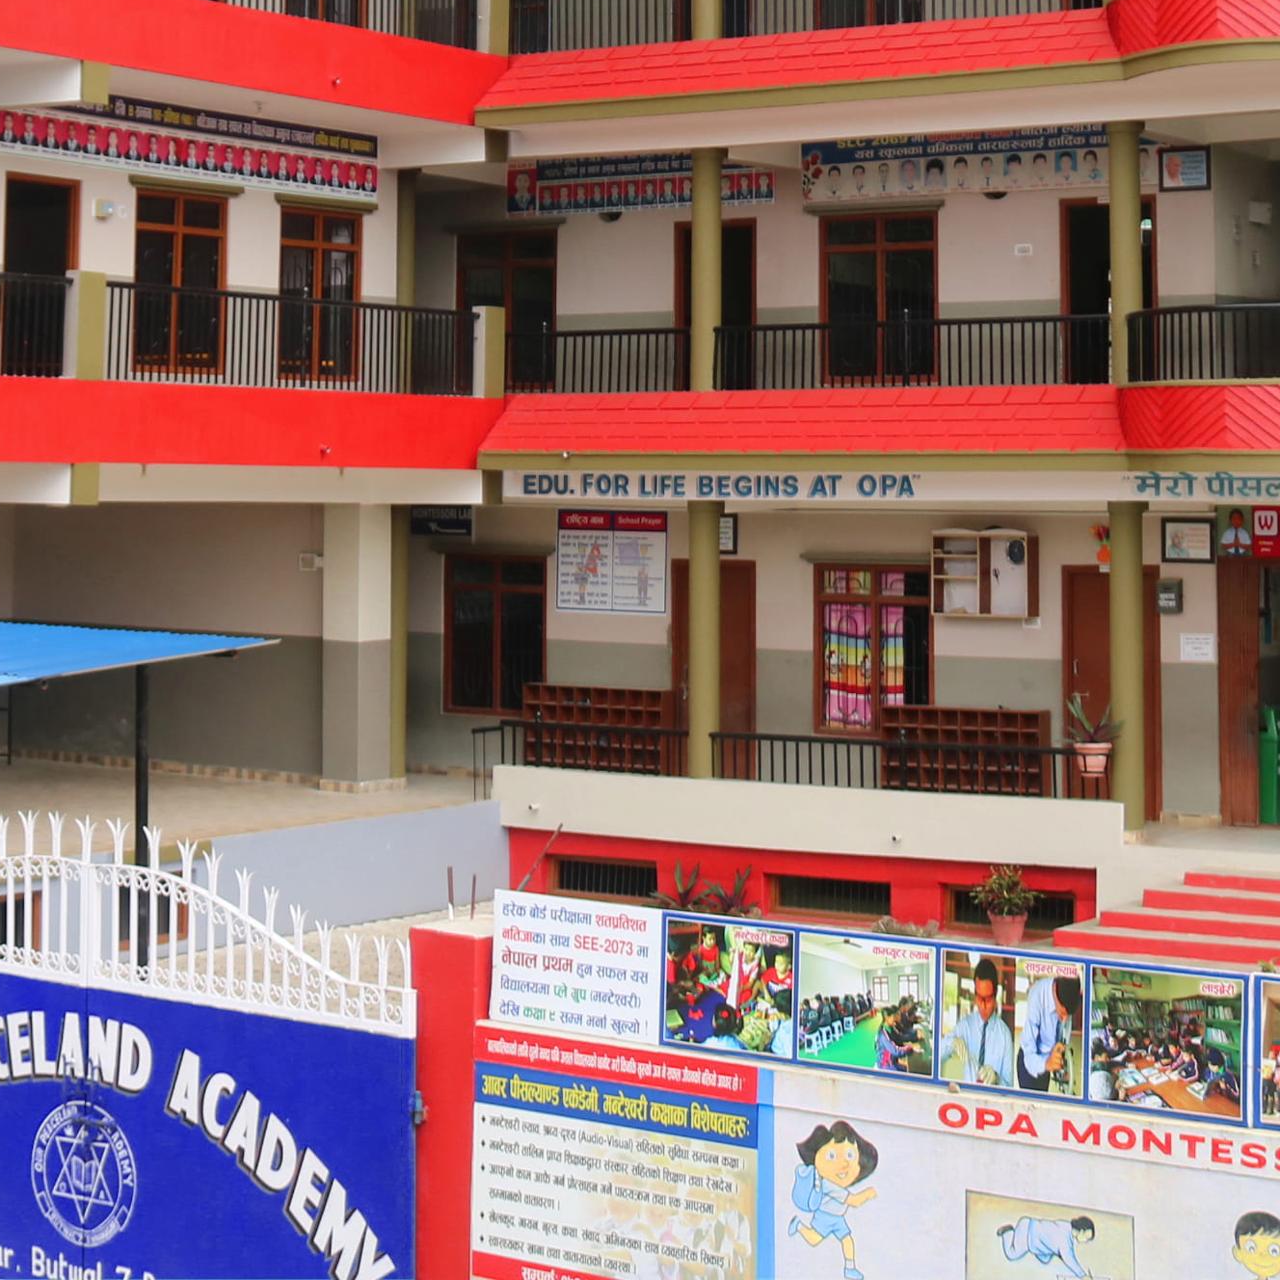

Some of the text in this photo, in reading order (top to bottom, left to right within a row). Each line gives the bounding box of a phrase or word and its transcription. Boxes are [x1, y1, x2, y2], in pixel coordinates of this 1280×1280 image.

[522, 473, 575, 497] EDU.
[581, 473, 629, 497] FOR
[638, 474, 686, 497] LIFE
[697, 473, 799, 499] BEGINS
[808, 474, 842, 499] AT
[502, 900, 647, 932] हरेक बोर्ड परीक्षामा शतप्रतिशत
[502, 925, 649, 958] नतिजाका साथ SEE-2073 मा
[501, 946, 648, 984] नेपाल प्रथम हुन सफल यस
[553, 983, 567, 998] प्ले
[500, 1000, 520, 1017] देखि
[523, 1006, 545, 1021] कक्षा
[559, 1010, 583, 1025] सम्म
[586, 1014, 607, 1029] भर्ना
[481, 1073, 508, 1096] आवर
[650, 1100, 688, 1126] कक्षाका
[937, 1103, 1038, 1138] OPA
[165, 1048, 398, 1280] ACADEMY
